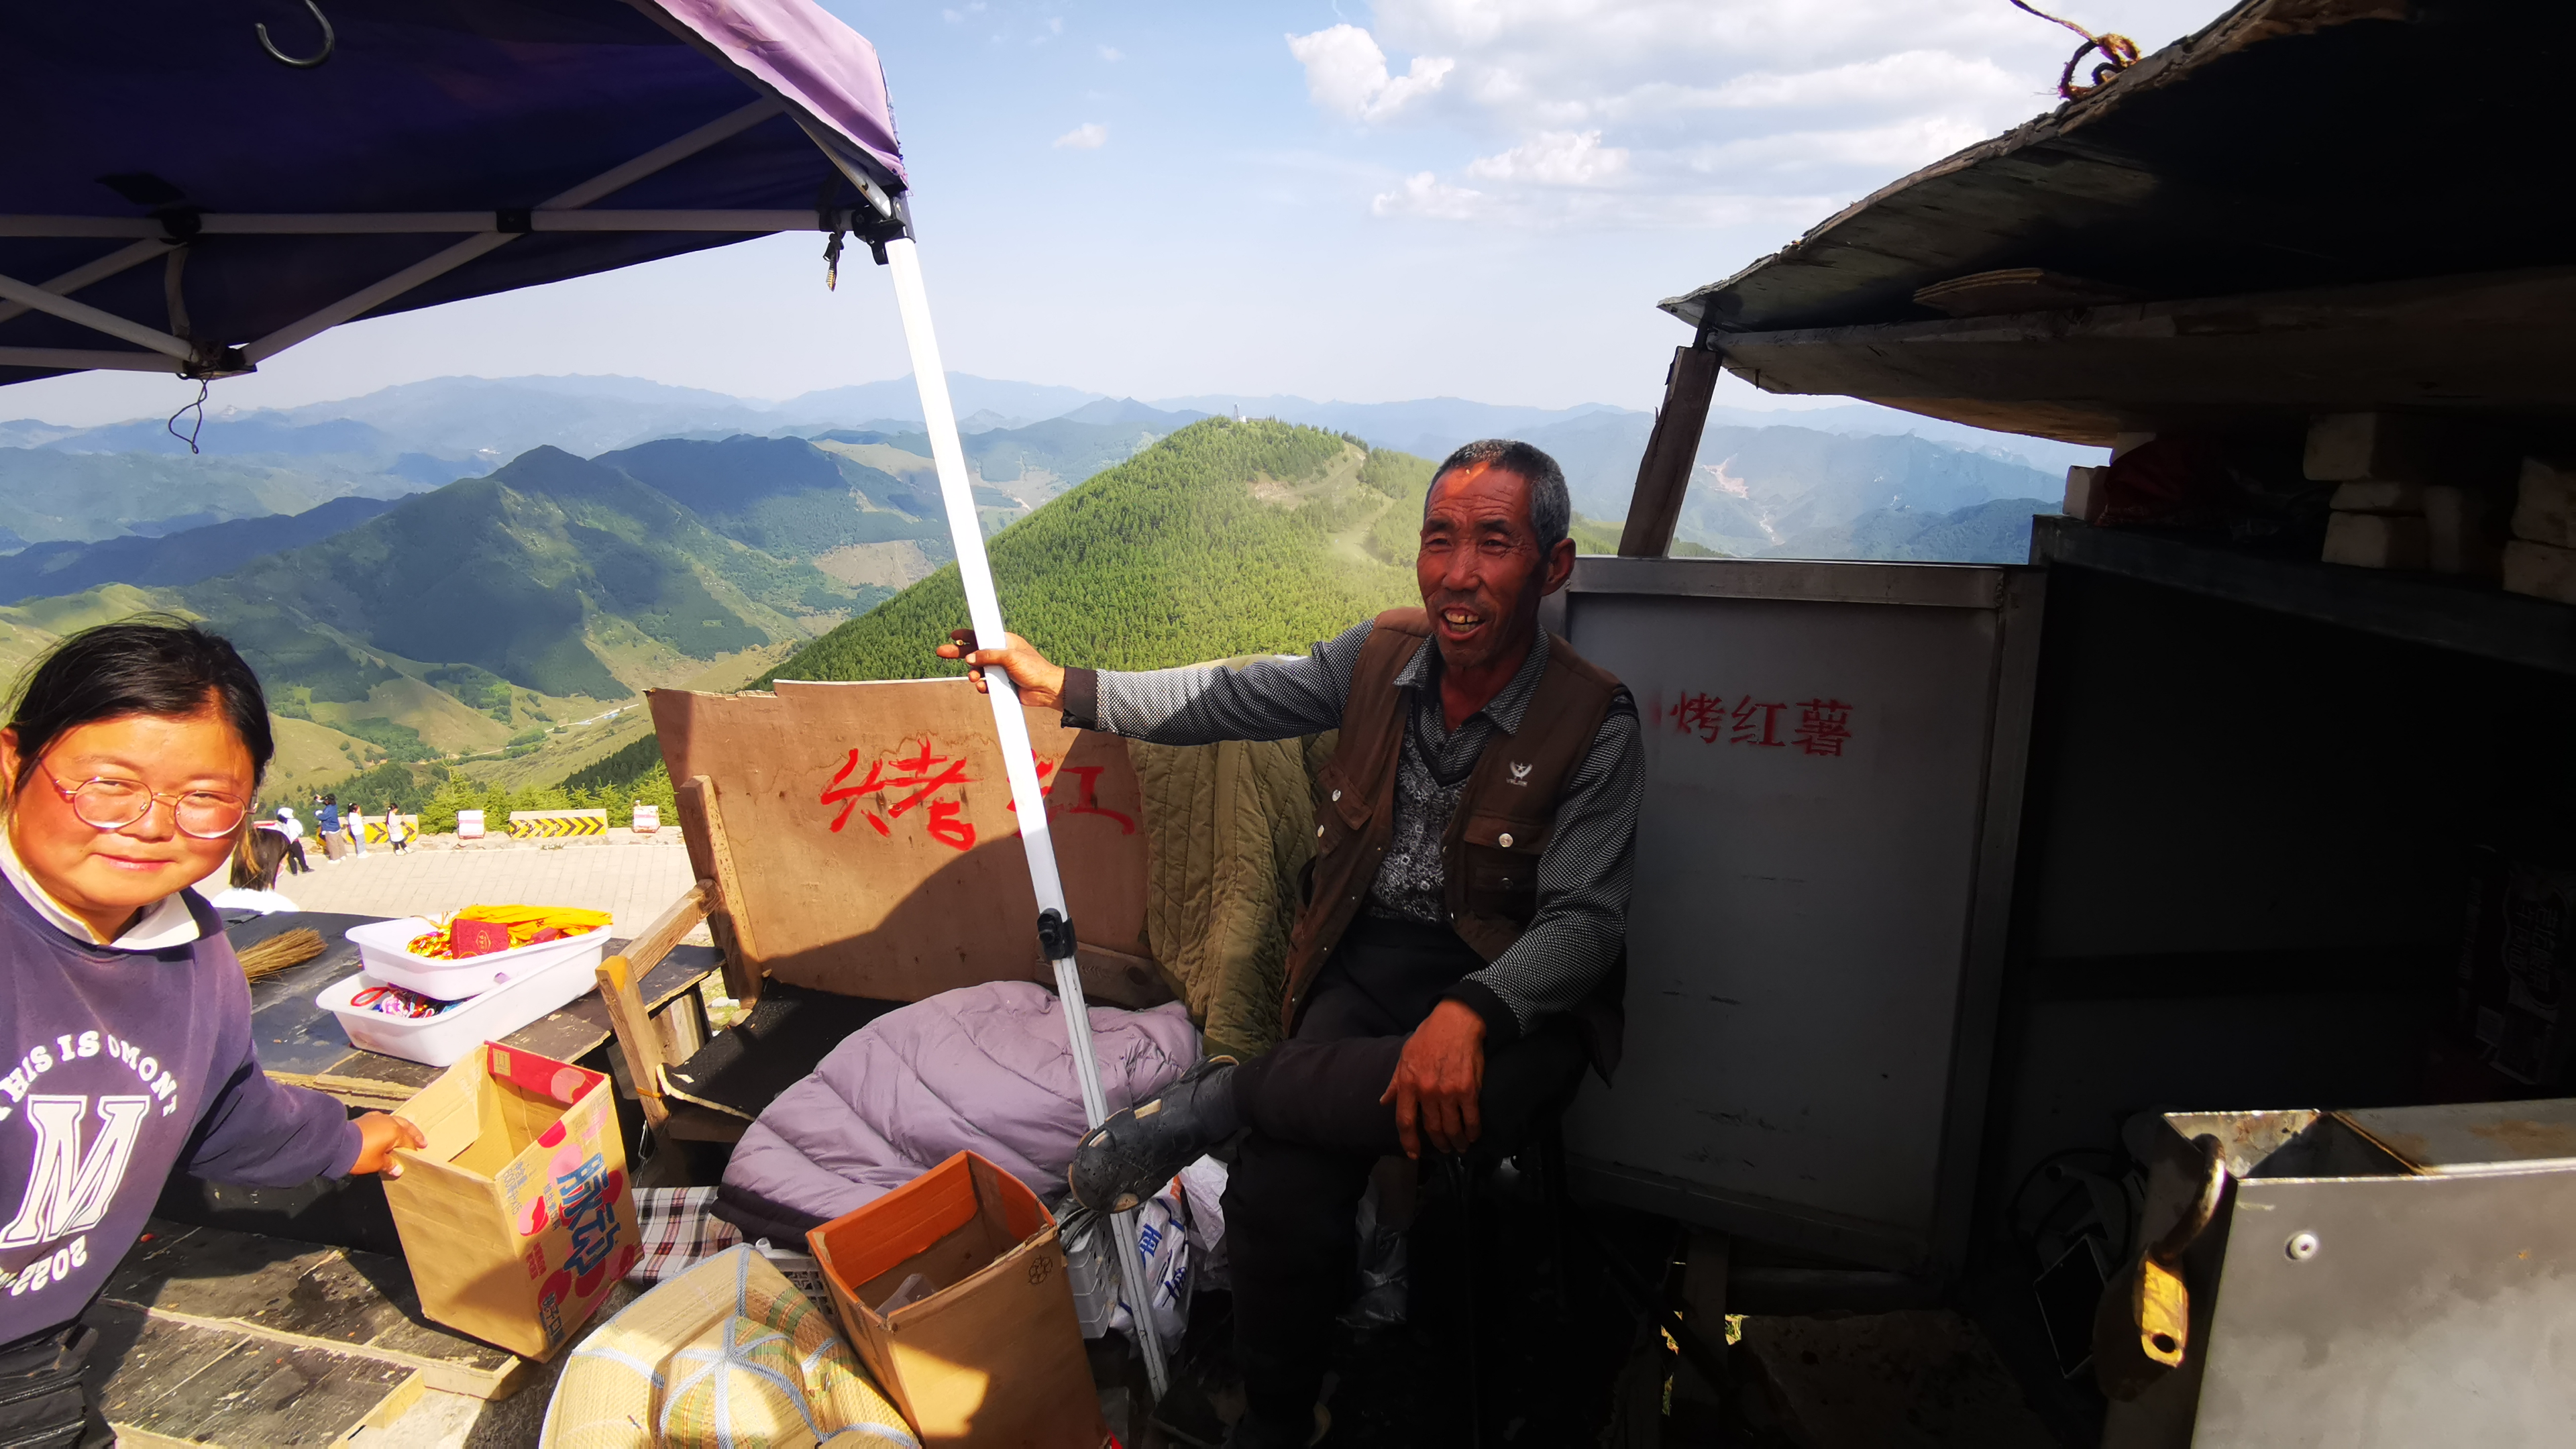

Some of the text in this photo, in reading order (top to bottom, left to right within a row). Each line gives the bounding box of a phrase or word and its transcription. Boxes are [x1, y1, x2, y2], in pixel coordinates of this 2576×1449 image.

[1670, 690, 1854, 757] 烤红薯
[56, 1030, 101, 1062] IS
[0, 1094, 150, 1249] M
[555, 1152, 621, 1277] 脉动
